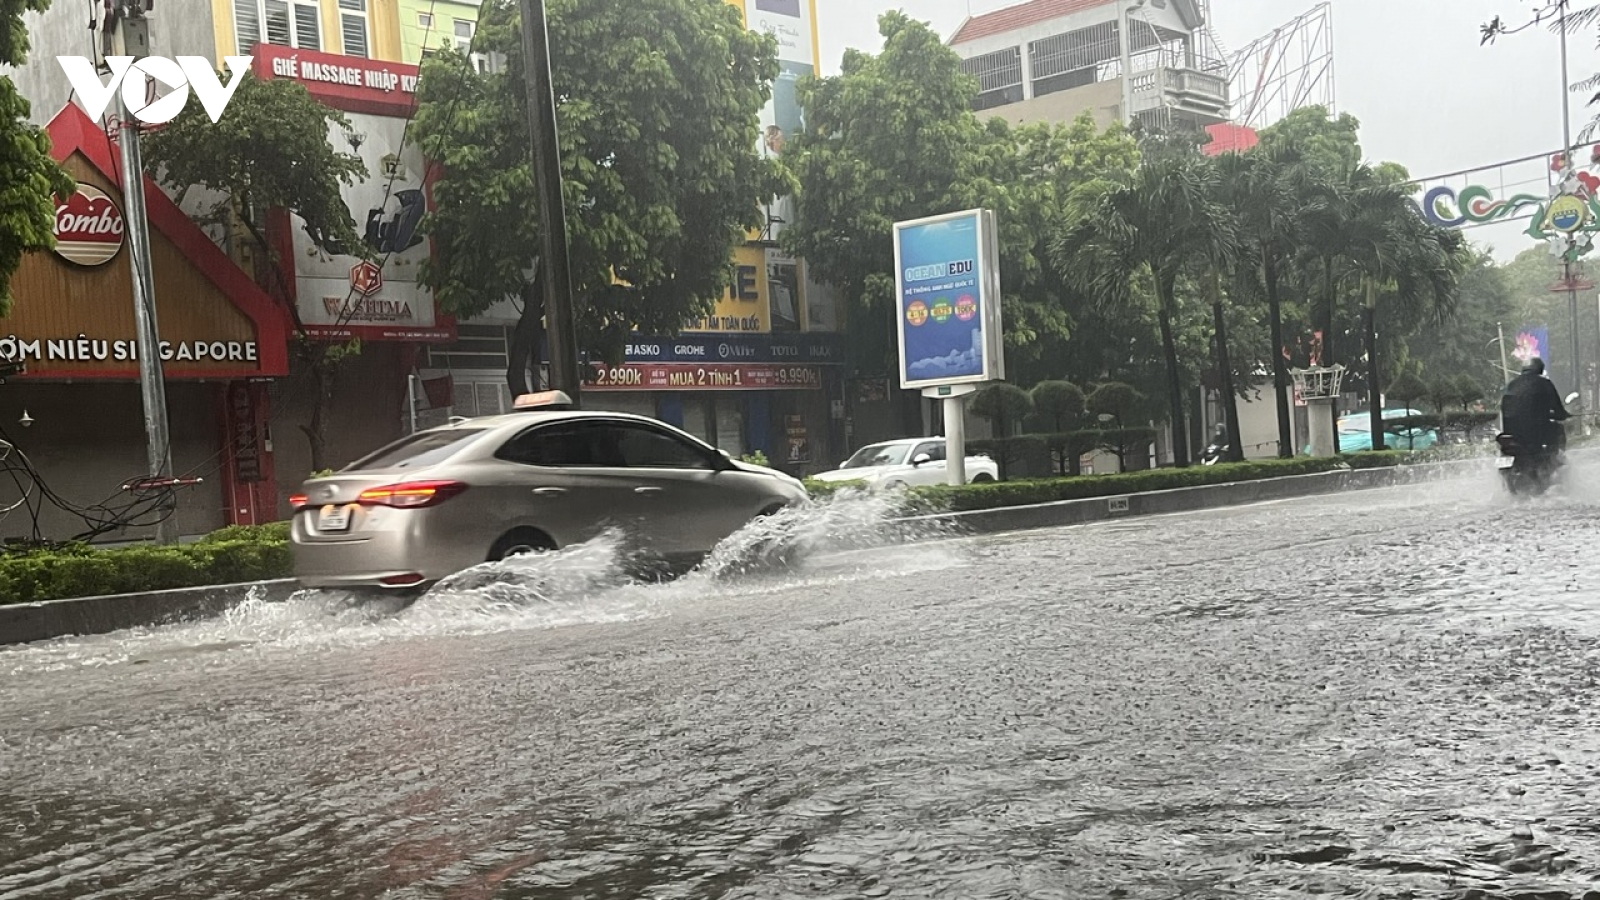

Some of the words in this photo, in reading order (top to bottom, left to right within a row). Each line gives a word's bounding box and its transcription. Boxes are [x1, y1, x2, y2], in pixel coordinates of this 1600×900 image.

[272, 54, 298, 77] GHẾ
[301, 61, 362, 86] MASSAGE
[364, 69, 399, 93] NHẬP
[905, 263, 945, 281] OCEAN
[949, 260, 972, 275] EDU
[721, 314, 740, 330] TOÀN
[741, 313, 760, 331] QUỐC
[47, 333, 108, 360] NIÊU
[113, 340, 257, 361] SIGAPORE
[634, 345, 660, 356] ASKO
[674, 345, 705, 356] GROHE
[770, 345, 798, 356] TOTO
[597, 368, 642, 386] 2.990k
[670, 371, 695, 386] MUA
[697, 369, 706, 386] 2
[708, 369, 732, 386] TÍNH
[734, 369, 742, 386] 1
